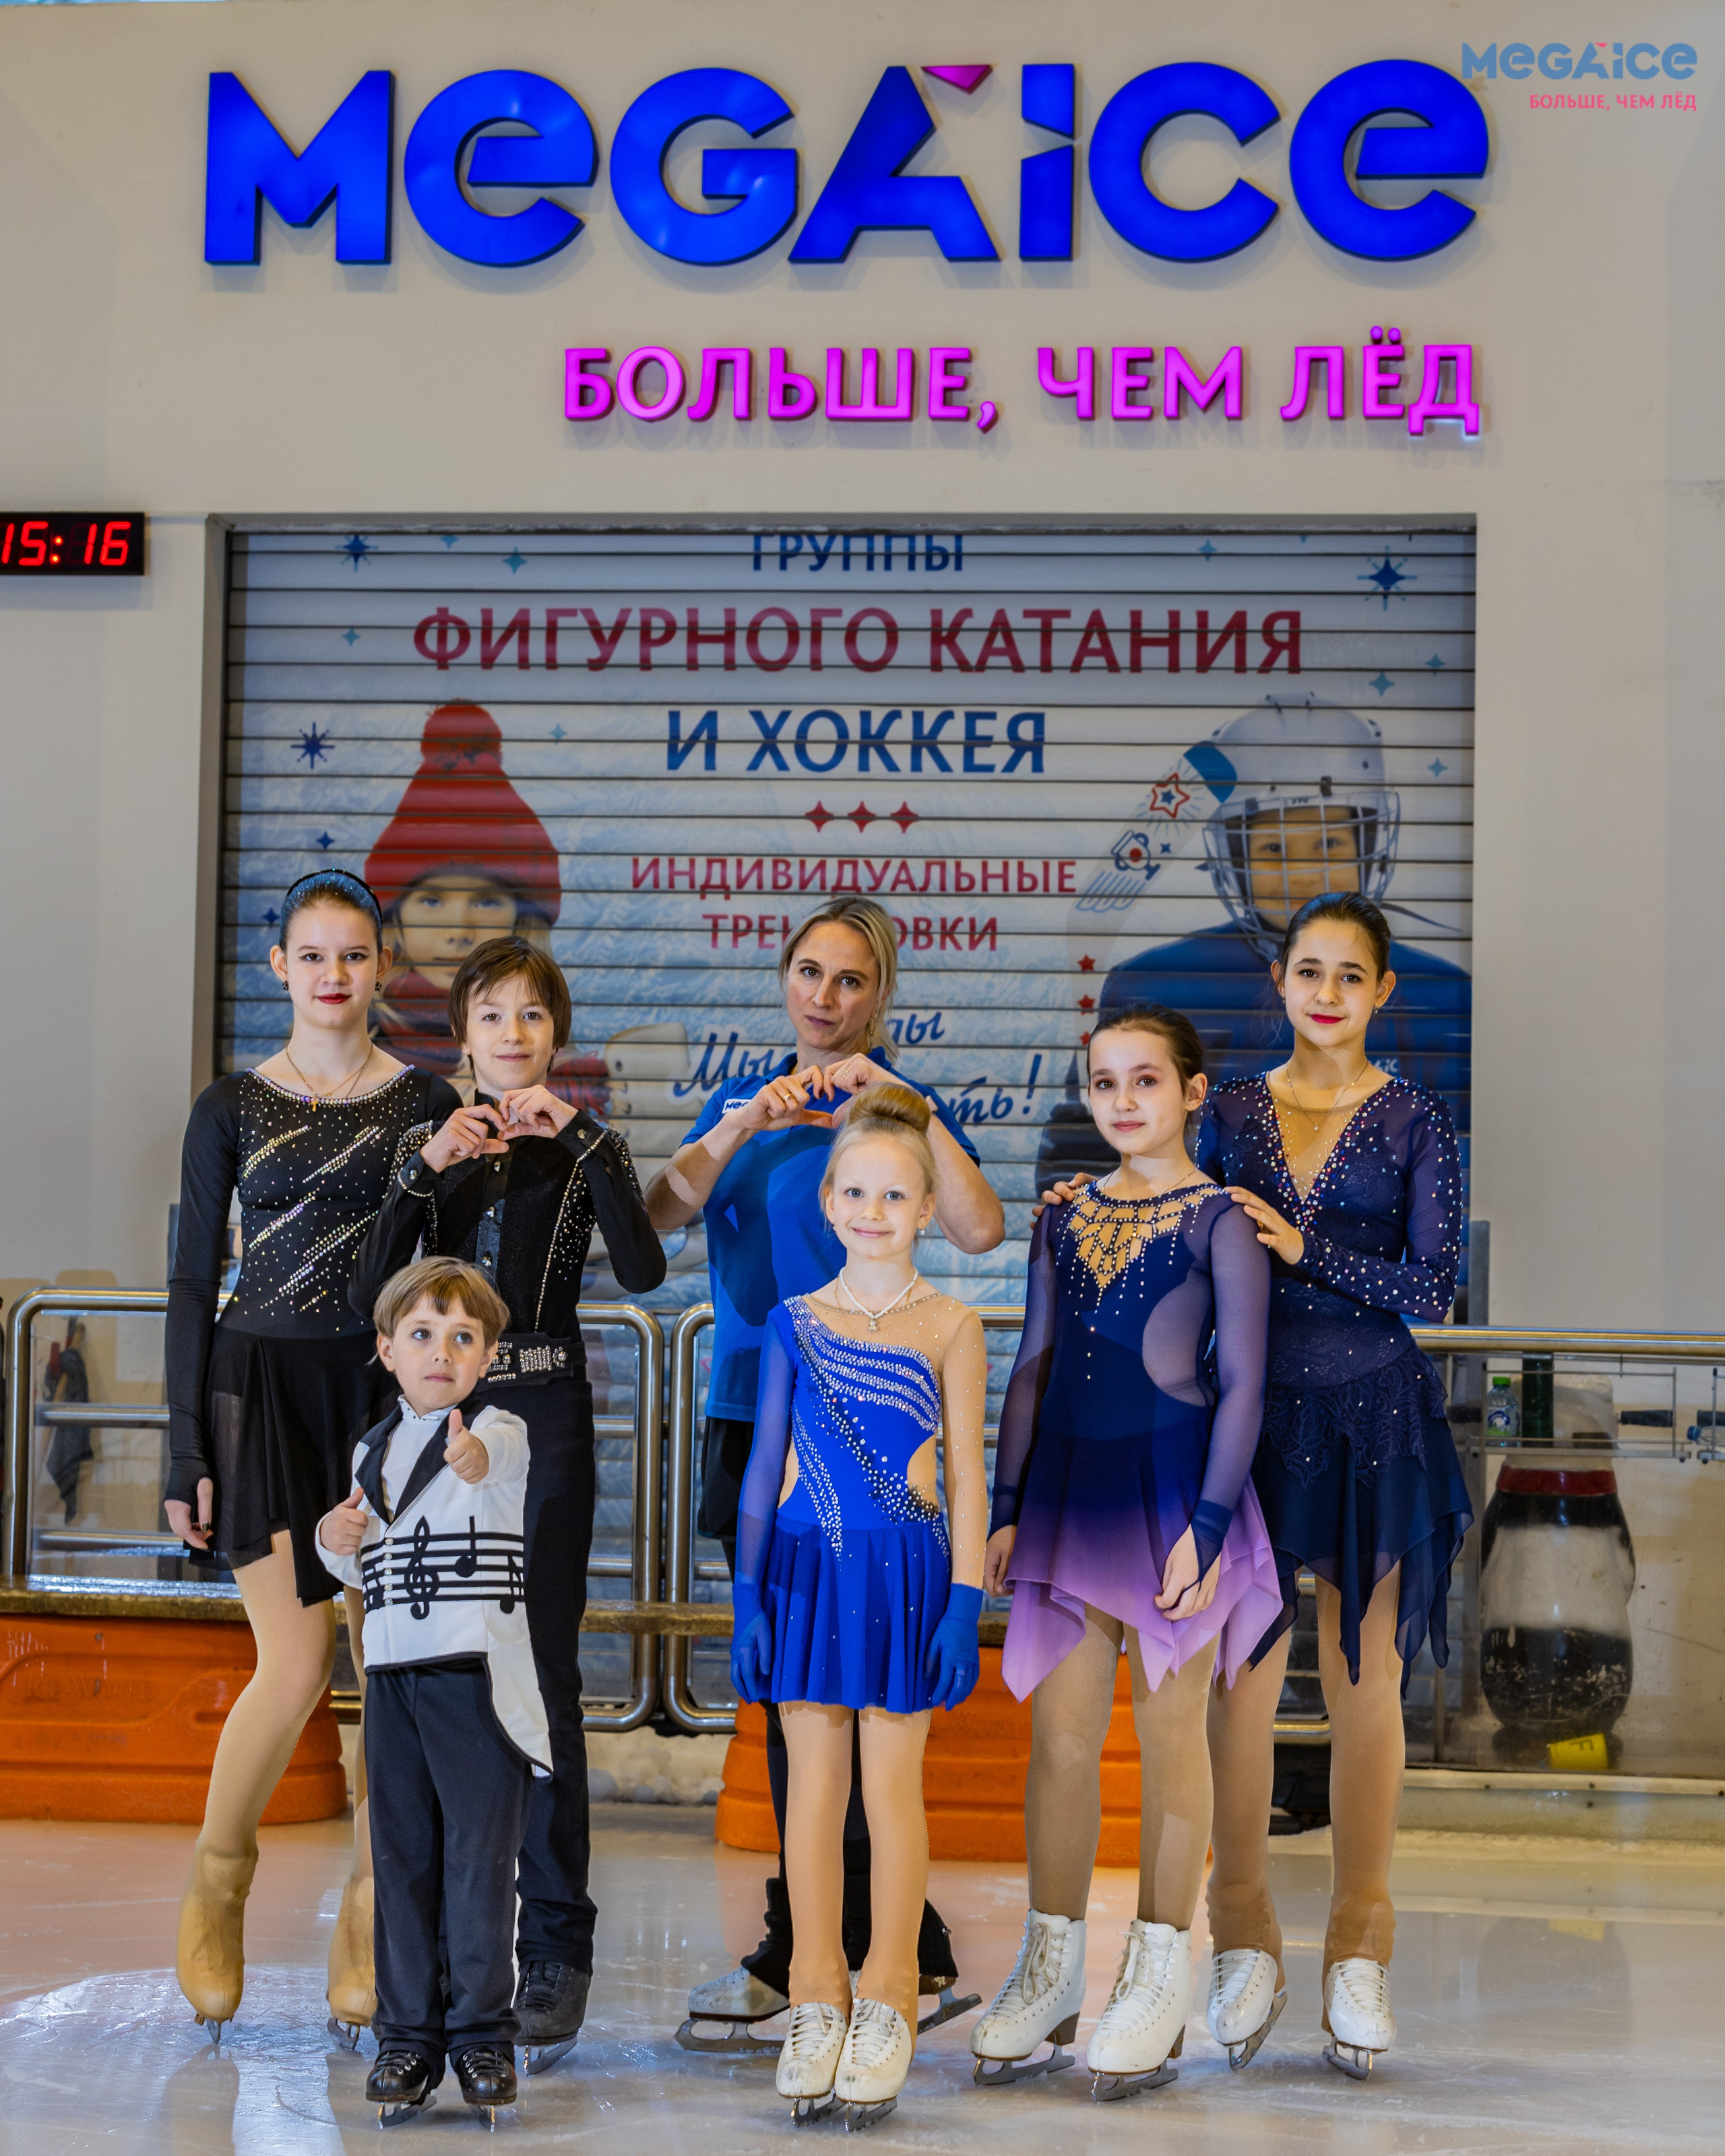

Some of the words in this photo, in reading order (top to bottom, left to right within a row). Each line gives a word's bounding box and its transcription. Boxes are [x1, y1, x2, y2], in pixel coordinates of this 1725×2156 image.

[564, 346, 999, 432] БОЛЬШЕ,
[1038, 346, 1244, 421] ЧЕМ
[1280, 325, 1481, 435] ЛЁД
[1, 521, 132, 566] 15:16
[753, 534, 963, 573] ГРУППЫ
[413, 607, 900, 672] ФИГУРНОГО
[930, 608, 1302, 675] КАТАНИЯ
[666, 709, 719, 771] И
[746, 709, 1046, 774] ХОККЕЯ
[631, 856, 1077, 901] ИНДИВИДУАЛЬНЫЕ
